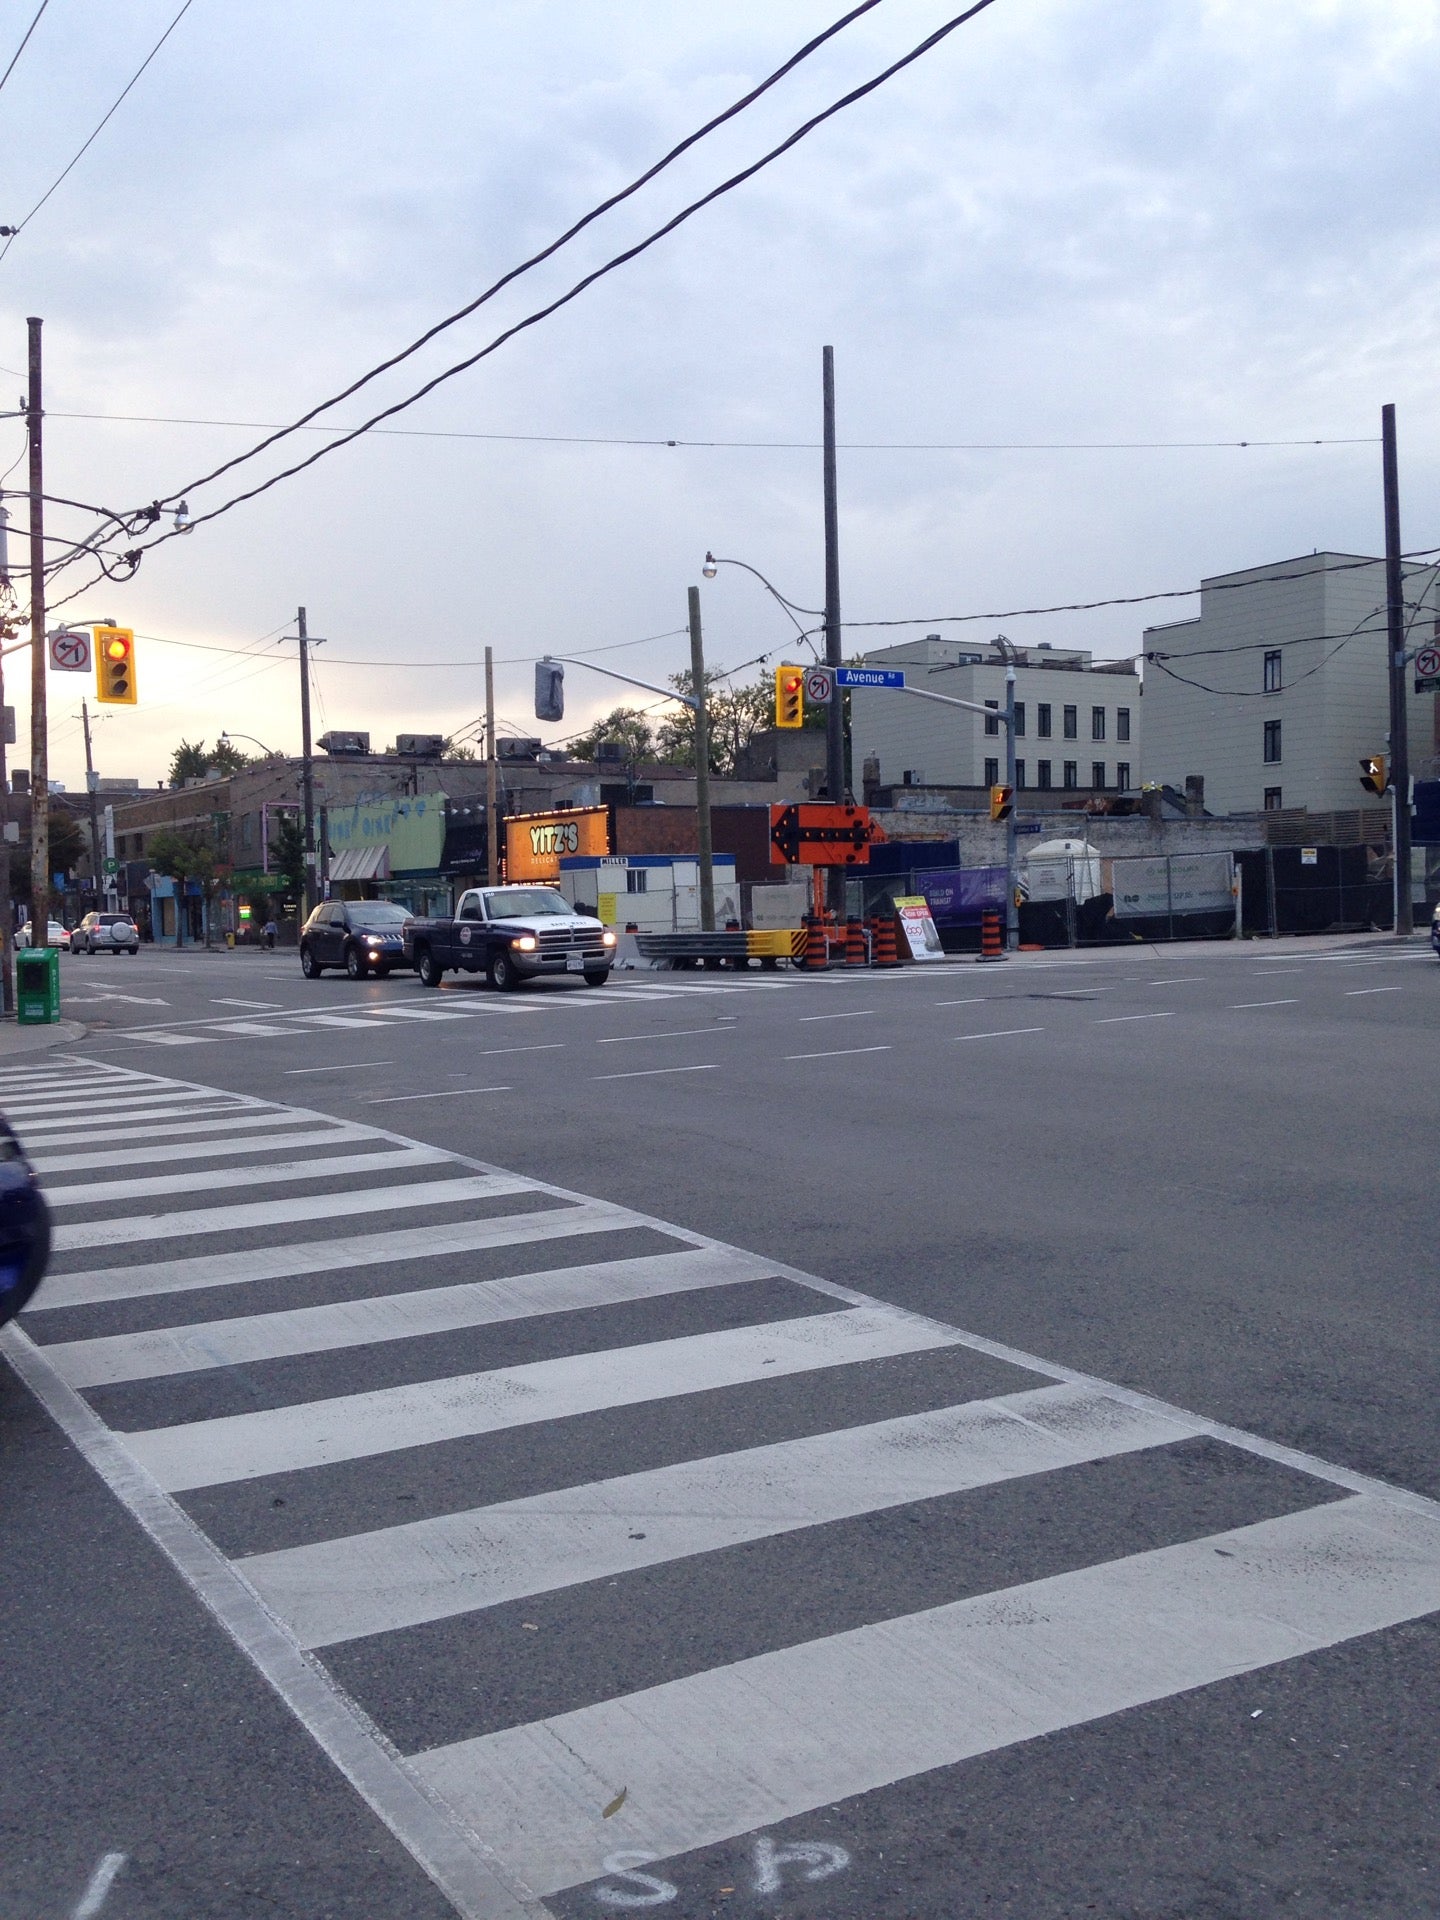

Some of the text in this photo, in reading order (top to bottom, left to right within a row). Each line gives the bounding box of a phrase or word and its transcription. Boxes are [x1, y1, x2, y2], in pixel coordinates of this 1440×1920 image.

[846, 670, 884, 684] Avenue
[530, 822, 578, 855] YITZ'S
[107, 861, 116, 869] P
[531, 856, 560, 865] DELICAT
